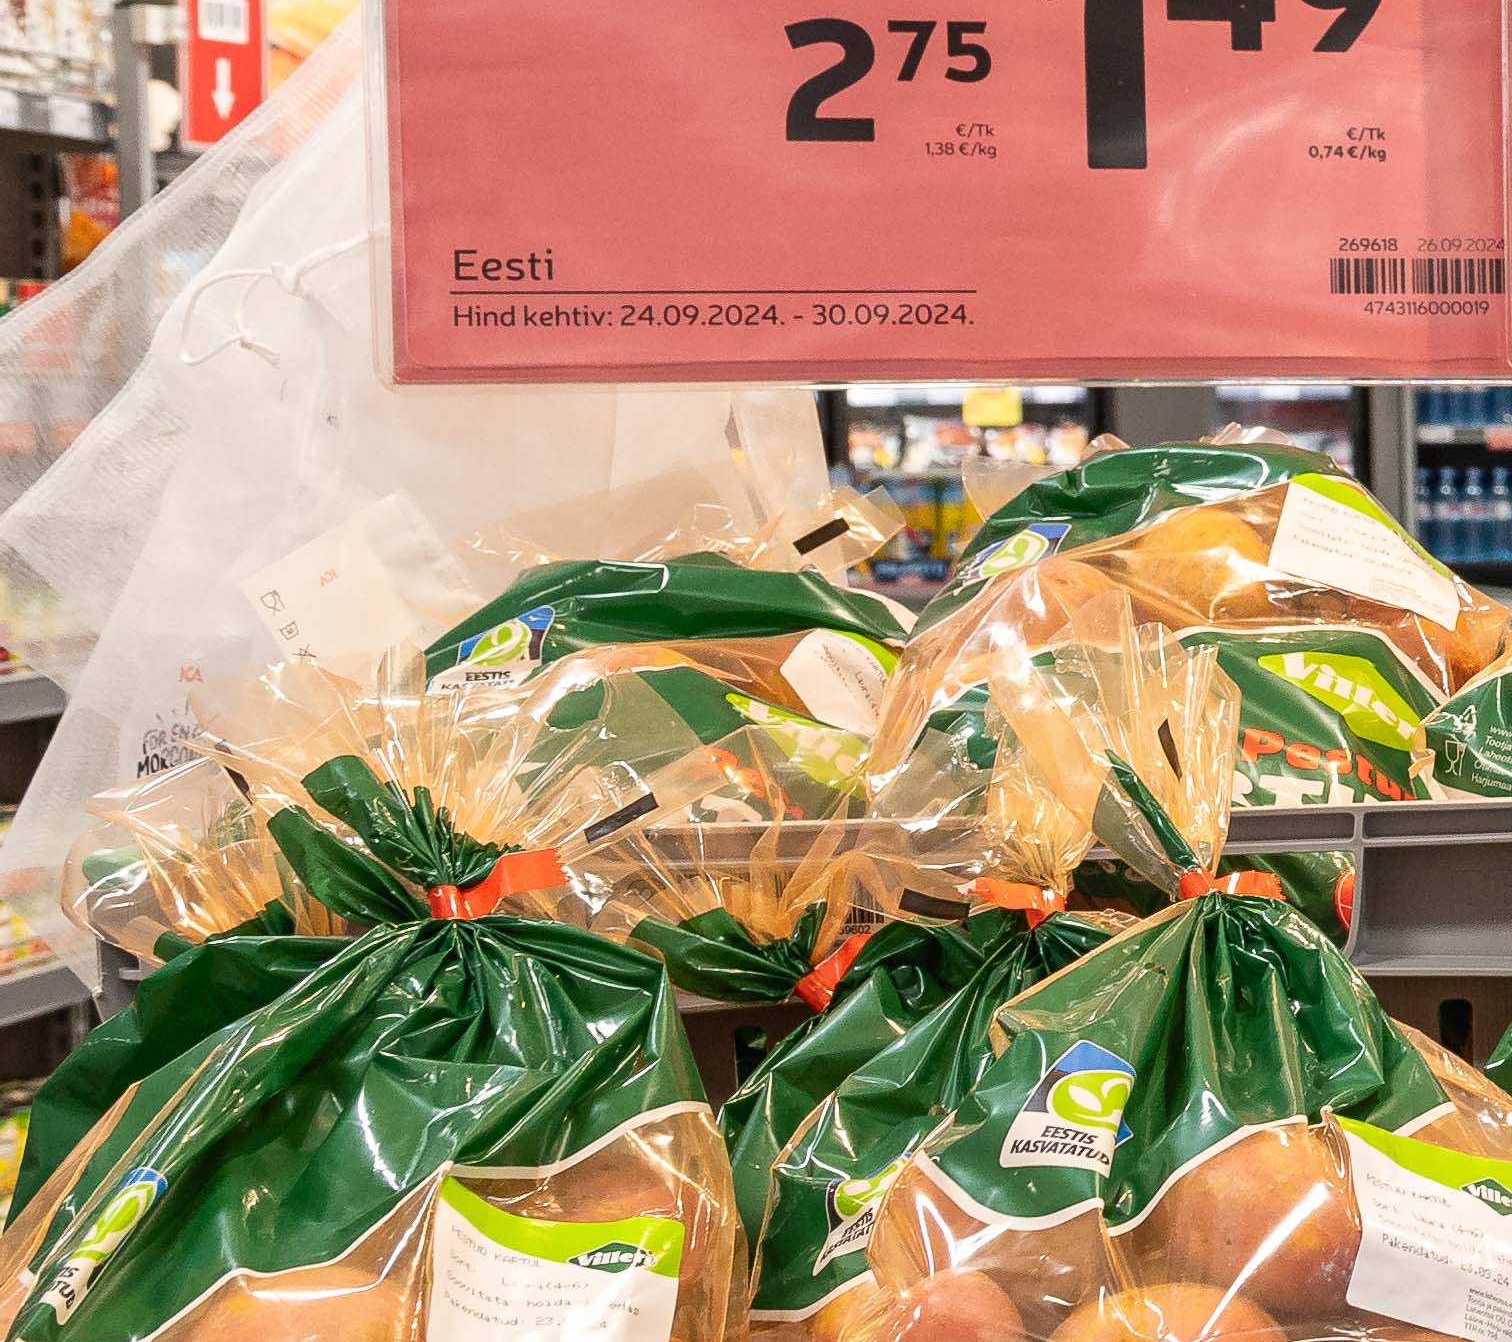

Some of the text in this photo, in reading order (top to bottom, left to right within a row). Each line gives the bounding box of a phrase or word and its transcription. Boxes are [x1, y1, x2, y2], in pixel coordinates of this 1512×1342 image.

[453, 248, 553, 282] Eesti
[620, 304, 785, 327] 24.09.2024.
[811, 303, 975, 326] 30.09.2024.
[465, 670, 511, 682] EESTIS
[1040, 1125, 1098, 1144] EESTIS
[1010, 1140, 1110, 1166] KASVATATUD
[576, 1248, 656, 1268] Villeri
